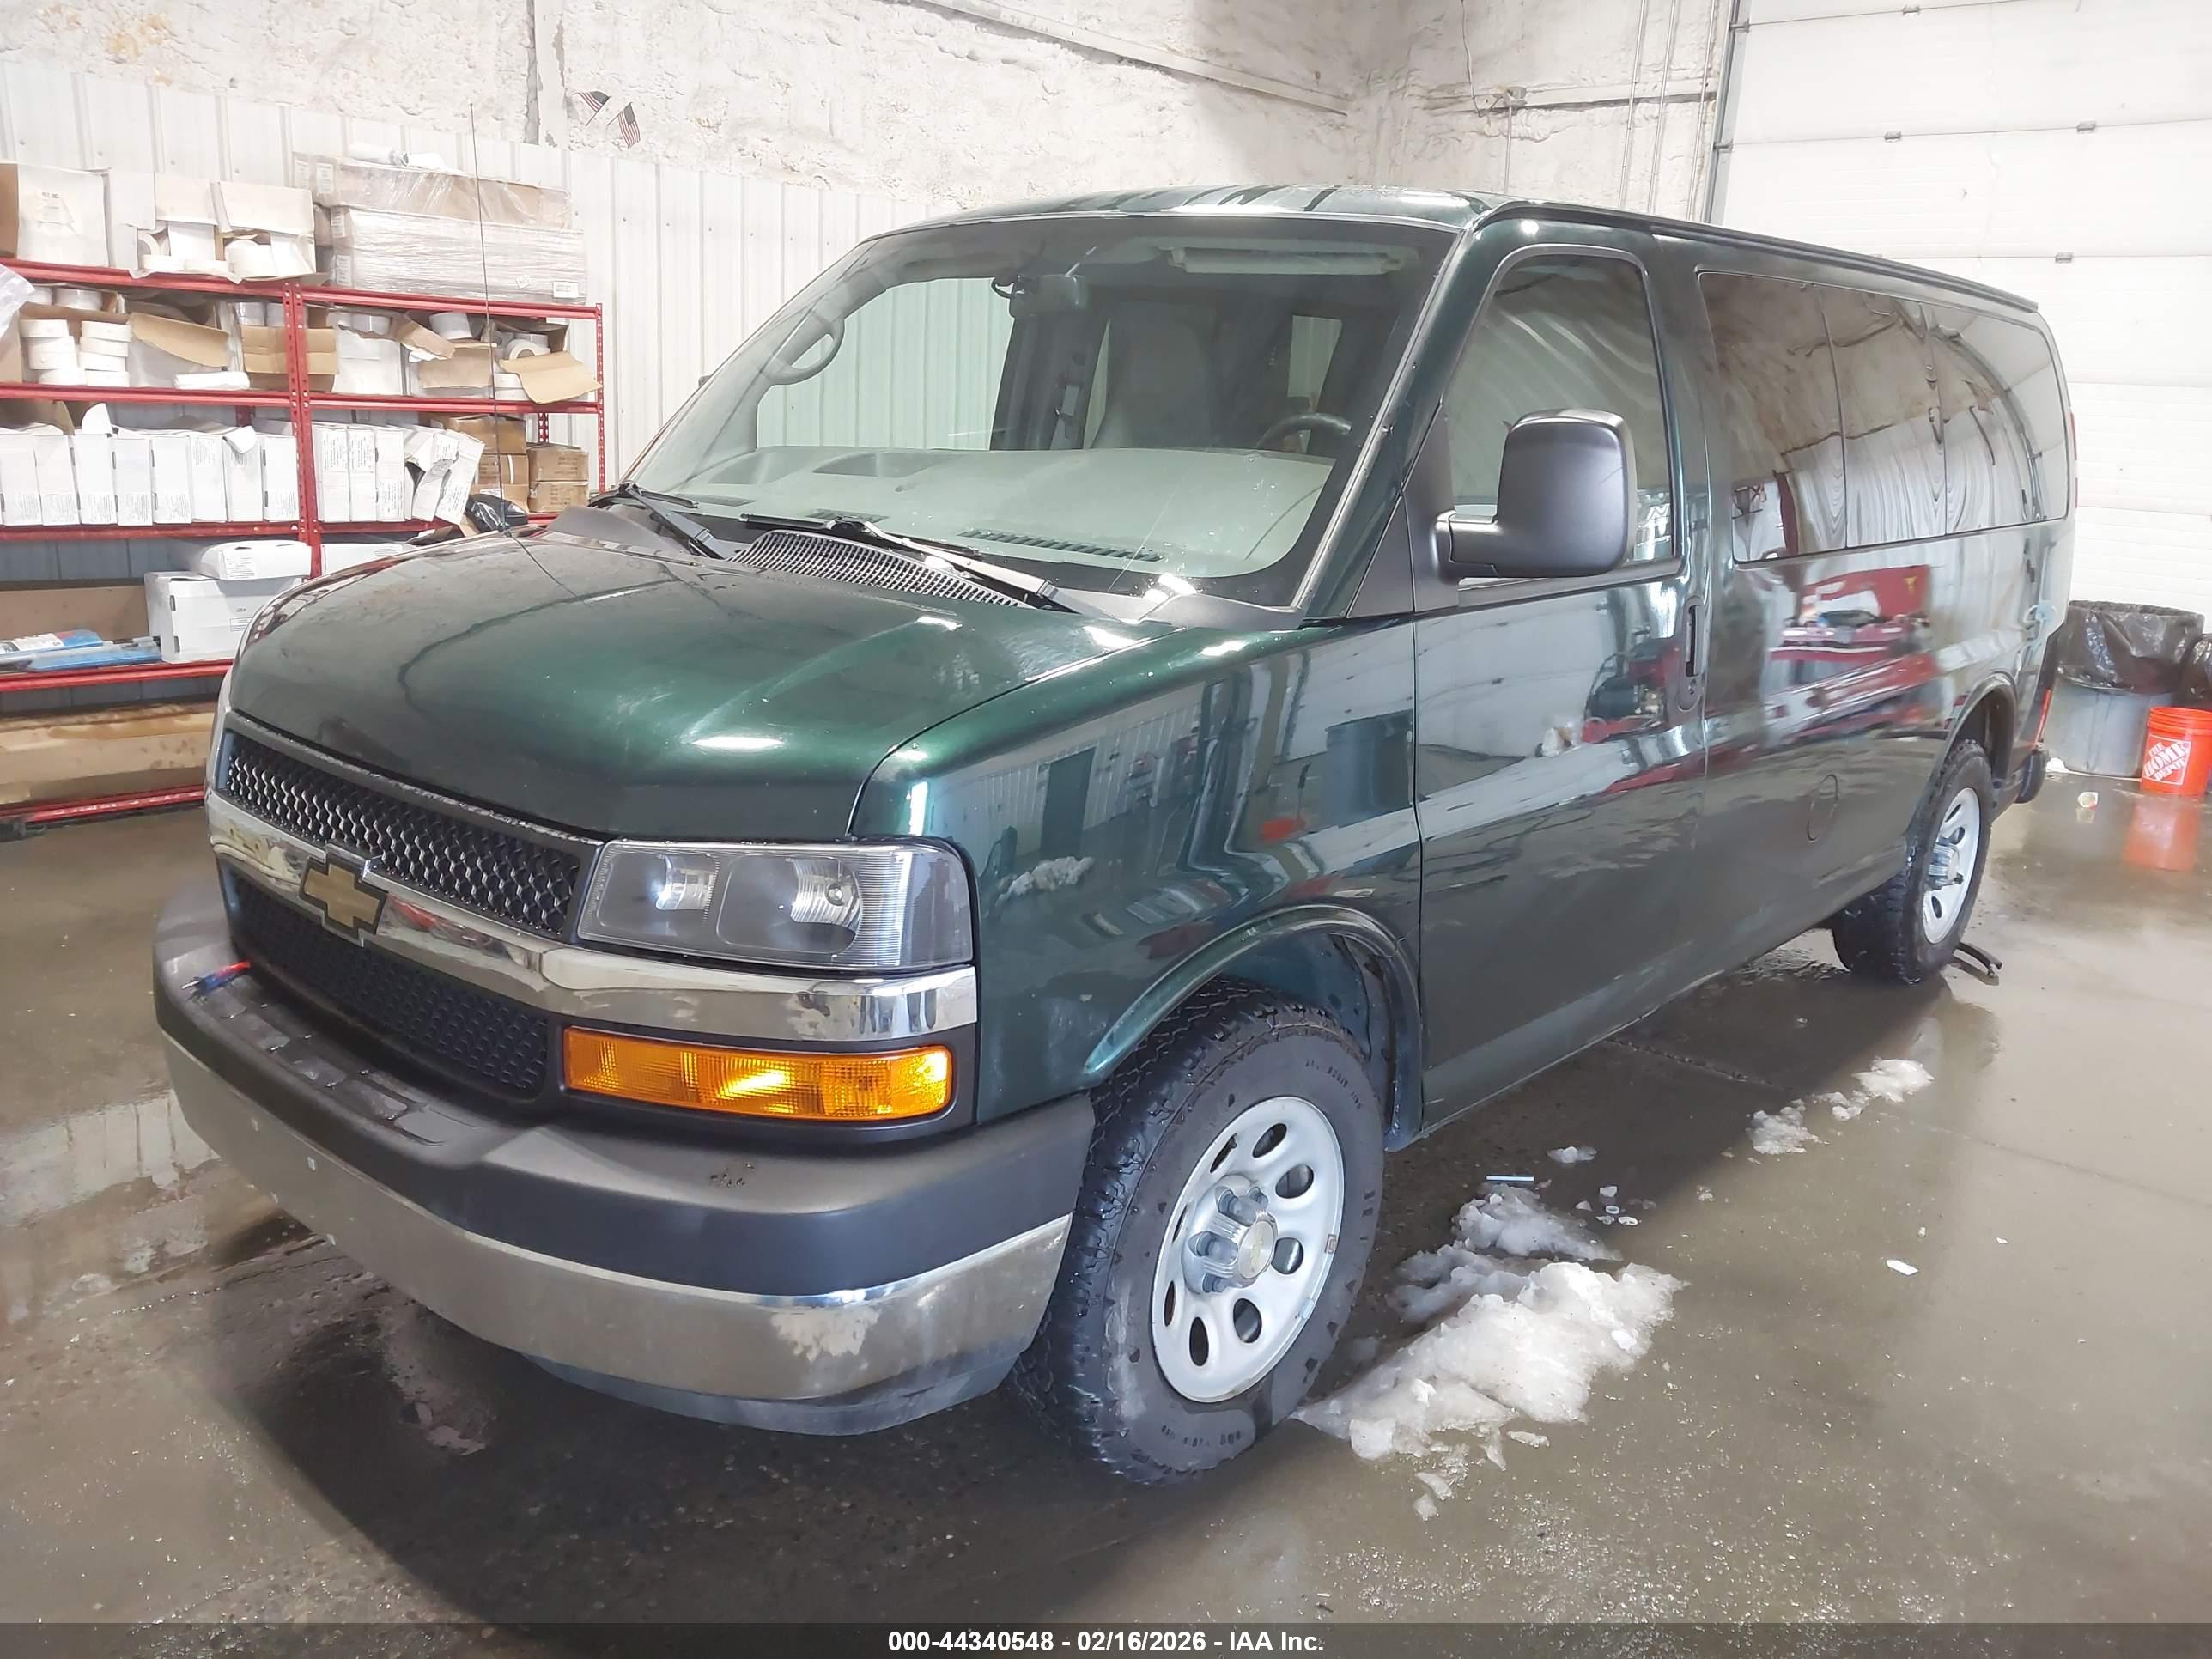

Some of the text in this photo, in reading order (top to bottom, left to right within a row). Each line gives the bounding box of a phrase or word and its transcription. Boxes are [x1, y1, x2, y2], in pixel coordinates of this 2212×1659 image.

[2144, 742, 2187, 777] HOME
[2148, 742, 2166, 757] THE
[2154, 756, 2186, 781] DEPOT
